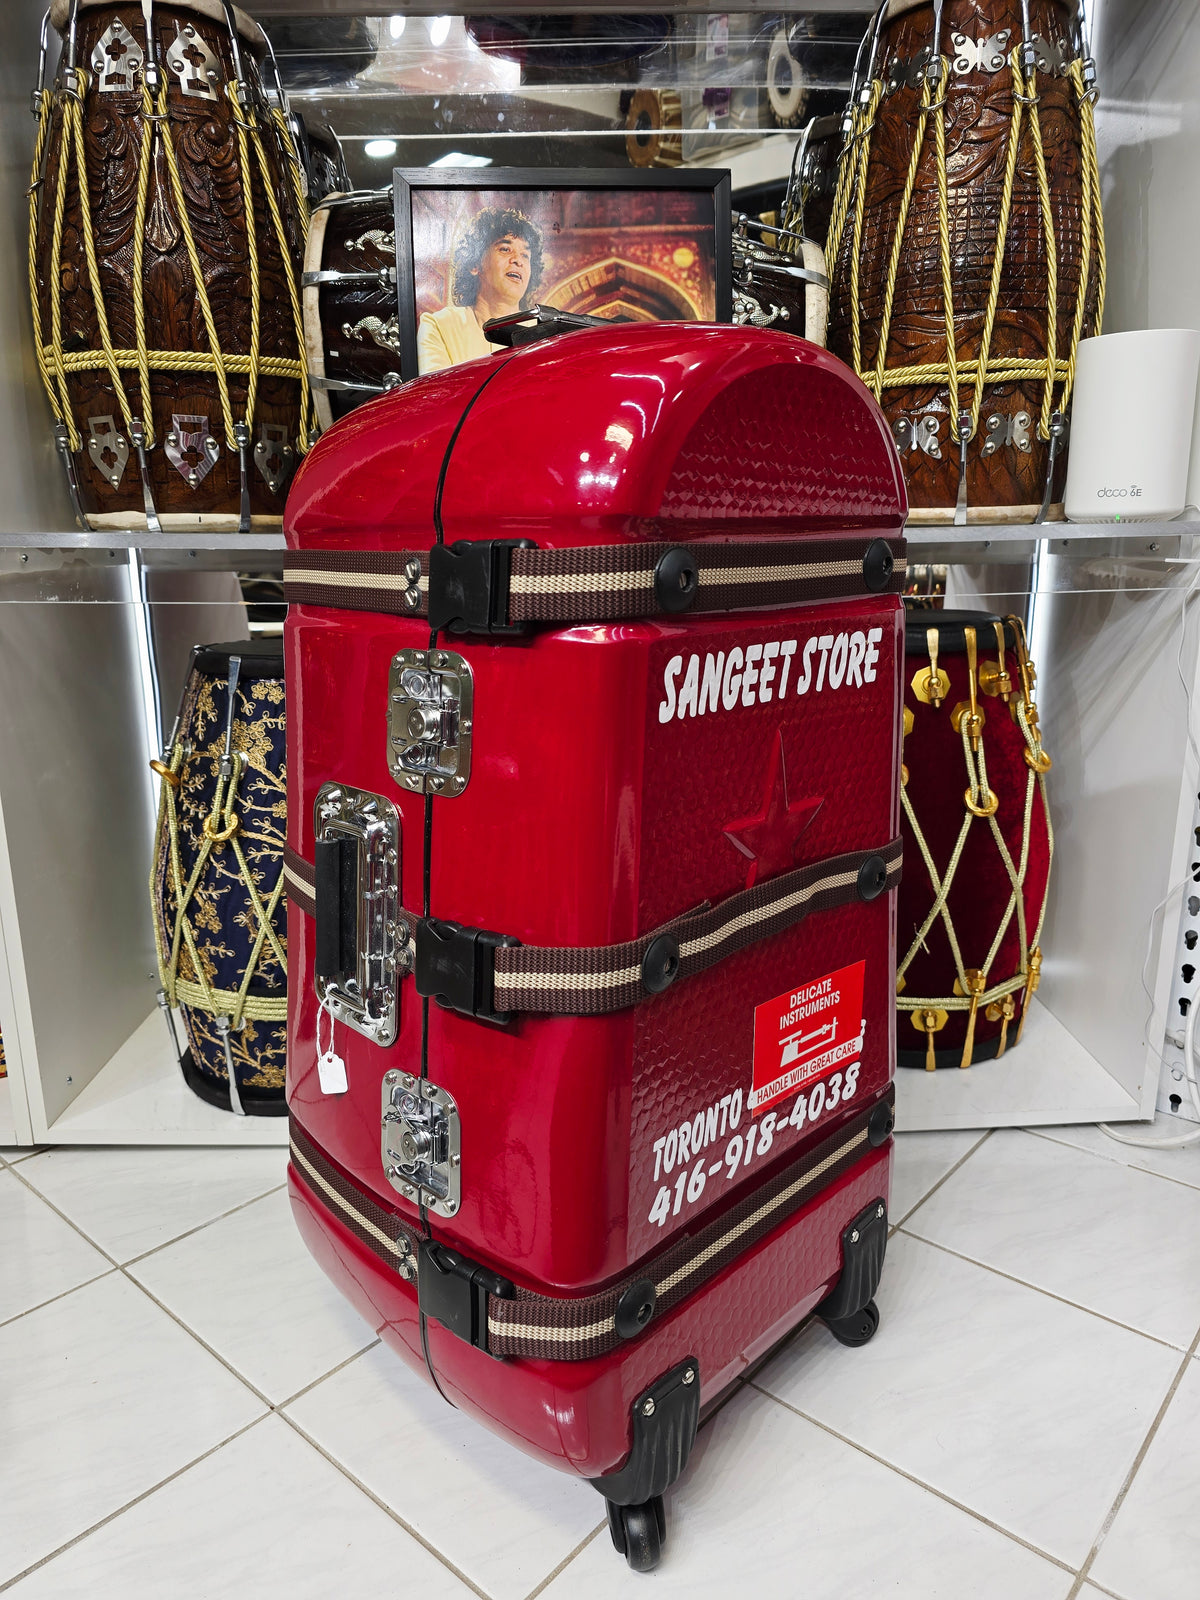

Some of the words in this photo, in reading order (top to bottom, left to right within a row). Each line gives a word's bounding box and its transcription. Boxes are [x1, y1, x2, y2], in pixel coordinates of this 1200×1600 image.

[1097, 488, 1127, 497] deco
[658, 640, 797, 724] SANGEET
[797, 627, 883, 695] STORE
[779, 990, 841, 1030] INSTRUMENTS
[789, 978, 832, 1008] DELICATE
[757, 1075, 788, 1104] HANDLE
[789, 1066, 808, 1084] WITH
[810, 1051, 835, 1073] GREAT
[835, 1040, 856, 1059] CARE
[649, 1061, 861, 1227] 416-918-4038
[653, 1088, 742, 1182] TORONTO
